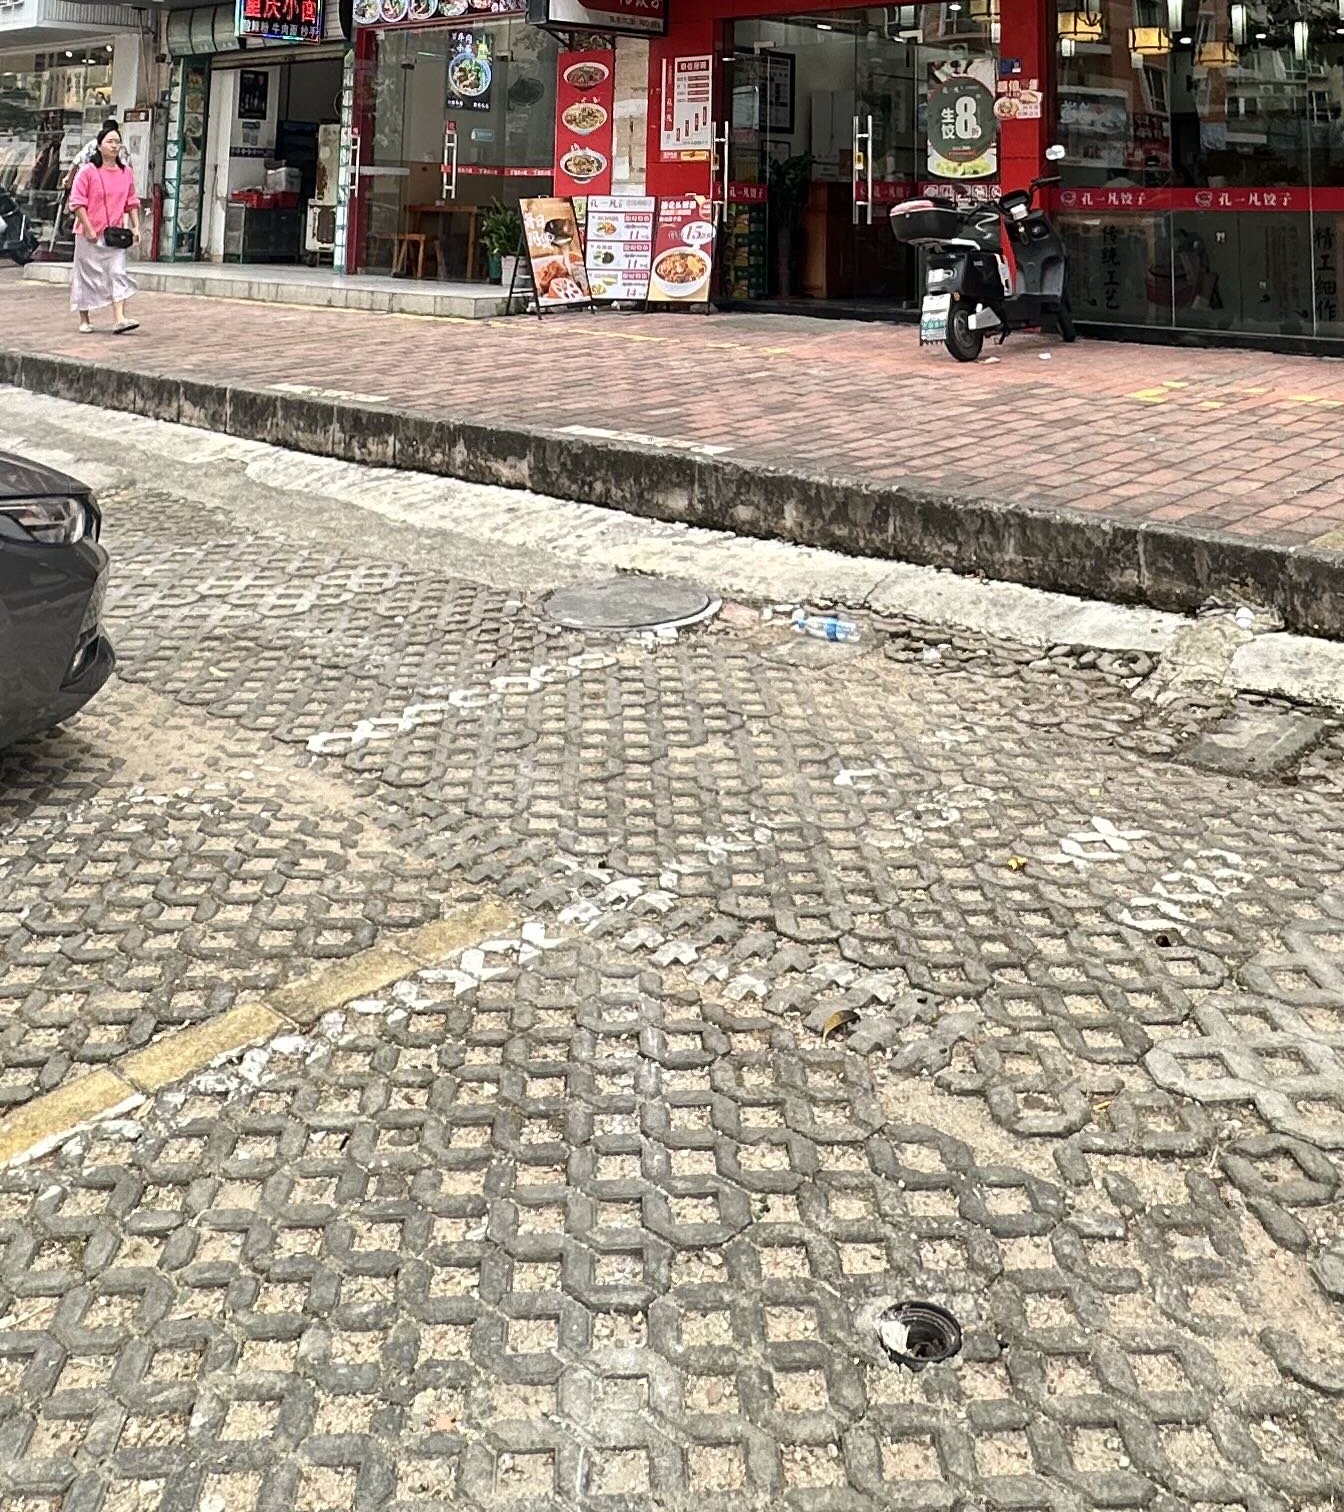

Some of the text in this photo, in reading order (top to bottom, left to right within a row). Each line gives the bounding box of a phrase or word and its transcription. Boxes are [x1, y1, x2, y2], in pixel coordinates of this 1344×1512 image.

[1082, 191, 1147, 206] 孔一凡饺子
[1219, 191, 1293, 207] 孔一凡饺子
